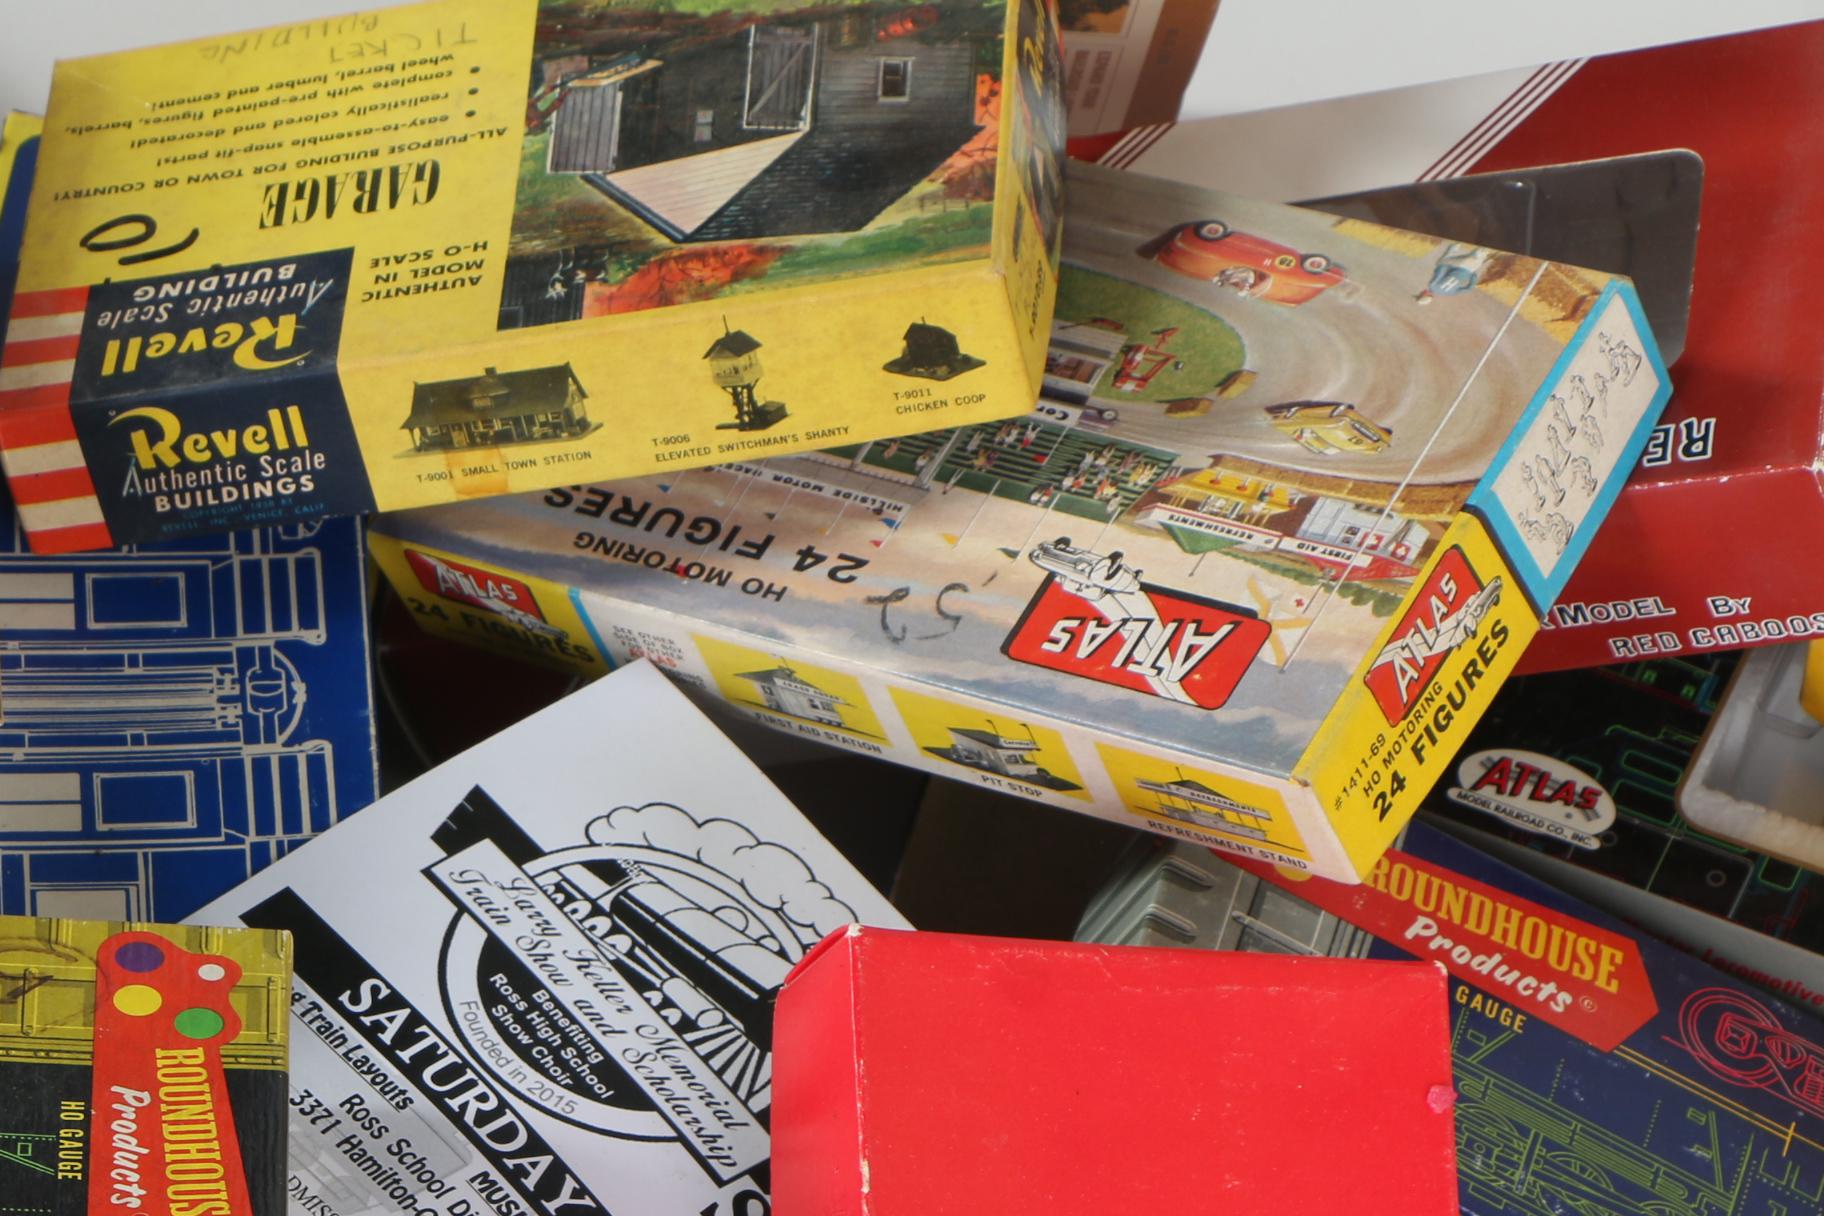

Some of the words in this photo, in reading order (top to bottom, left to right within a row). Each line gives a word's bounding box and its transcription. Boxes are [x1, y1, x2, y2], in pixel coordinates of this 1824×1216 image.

[295, 148, 379, 168] BUILDING
[387, 126, 506, 154] ALL-PURPOSE
[153, 177, 178, 188] OR
[186, 168, 242, 184] TOWN
[252, 161, 286, 174] FOR
[51, 182, 144, 204] COUNTRY!
[258, 159, 439, 229] GARAGE
[369, 249, 433, 268] SCALE
[409, 258, 484, 278] MODEL
[443, 240, 487, 256] H-O
[133, 263, 296, 301] BUILDING
[361, 274, 482, 302] AUTHENTIC
[373, 271, 397, 284] IN
[96, 302, 173, 329] Scale
[186, 278, 333, 330] Authentic
[101, 313, 310, 375] Revell
[893, 387, 931, 400] T-9011
[895, 399, 948, 415] CHICKEN
[954, 393, 986, 406] COOP
[110, 405, 308, 474] Revell
[122, 435, 246, 496] Authentic
[259, 449, 325, 477] Scale
[416, 468, 455, 482] T-9001
[461, 464, 498, 477] SMALL
[503, 459, 537, 471] TOWN
[543, 450, 592, 465] STATION
[155, 474, 314, 512] BUILDINGS
[543, 486, 775, 564] FIGURES
[572, 531, 735, 589] MOTORING
[792, 544, 869, 583] 24
[740, 577, 787, 601] HO
[1042, 614, 1240, 684] ATLAS
[1388, 572, 1459, 701] ATLAS
[1609, 632, 1682, 658] RED
[1362, 770, 1381, 797] HO
[1382, 681, 1443, 769] MOTORING
[1373, 769, 1406, 822] 24
[1410, 618, 1509, 765] FIGURES
[980, 770, 1009, 786] PIT
[1006, 782, 1042, 803] STOP
[1334, 732, 1386, 810] #1411-69
[1482, 757, 1606, 811] ATLAS
[1145, 820, 1255, 861] REFRESHMENT
[1261, 851, 1310, 871] STAND
[1365, 856, 1623, 995] ROUNDHOUSE
[1404, 915, 1573, 1013] Products
[1455, 986, 1527, 1035] GAUGE
[489, 973, 536, 1011] Ross
[525, 1010, 571, 1046] High
[550, 1047, 614, 1098] School
[61, 1101, 84, 1122] HO
[289, 1090, 340, 1136] 3371
[339, 978, 595, 1216] SATURDAY
[58, 1129, 82, 1181] GAUGE
[110, 1085, 151, 1208] Products
[338, 1094, 389, 1140] Ross
[386, 1138, 456, 1199] School
